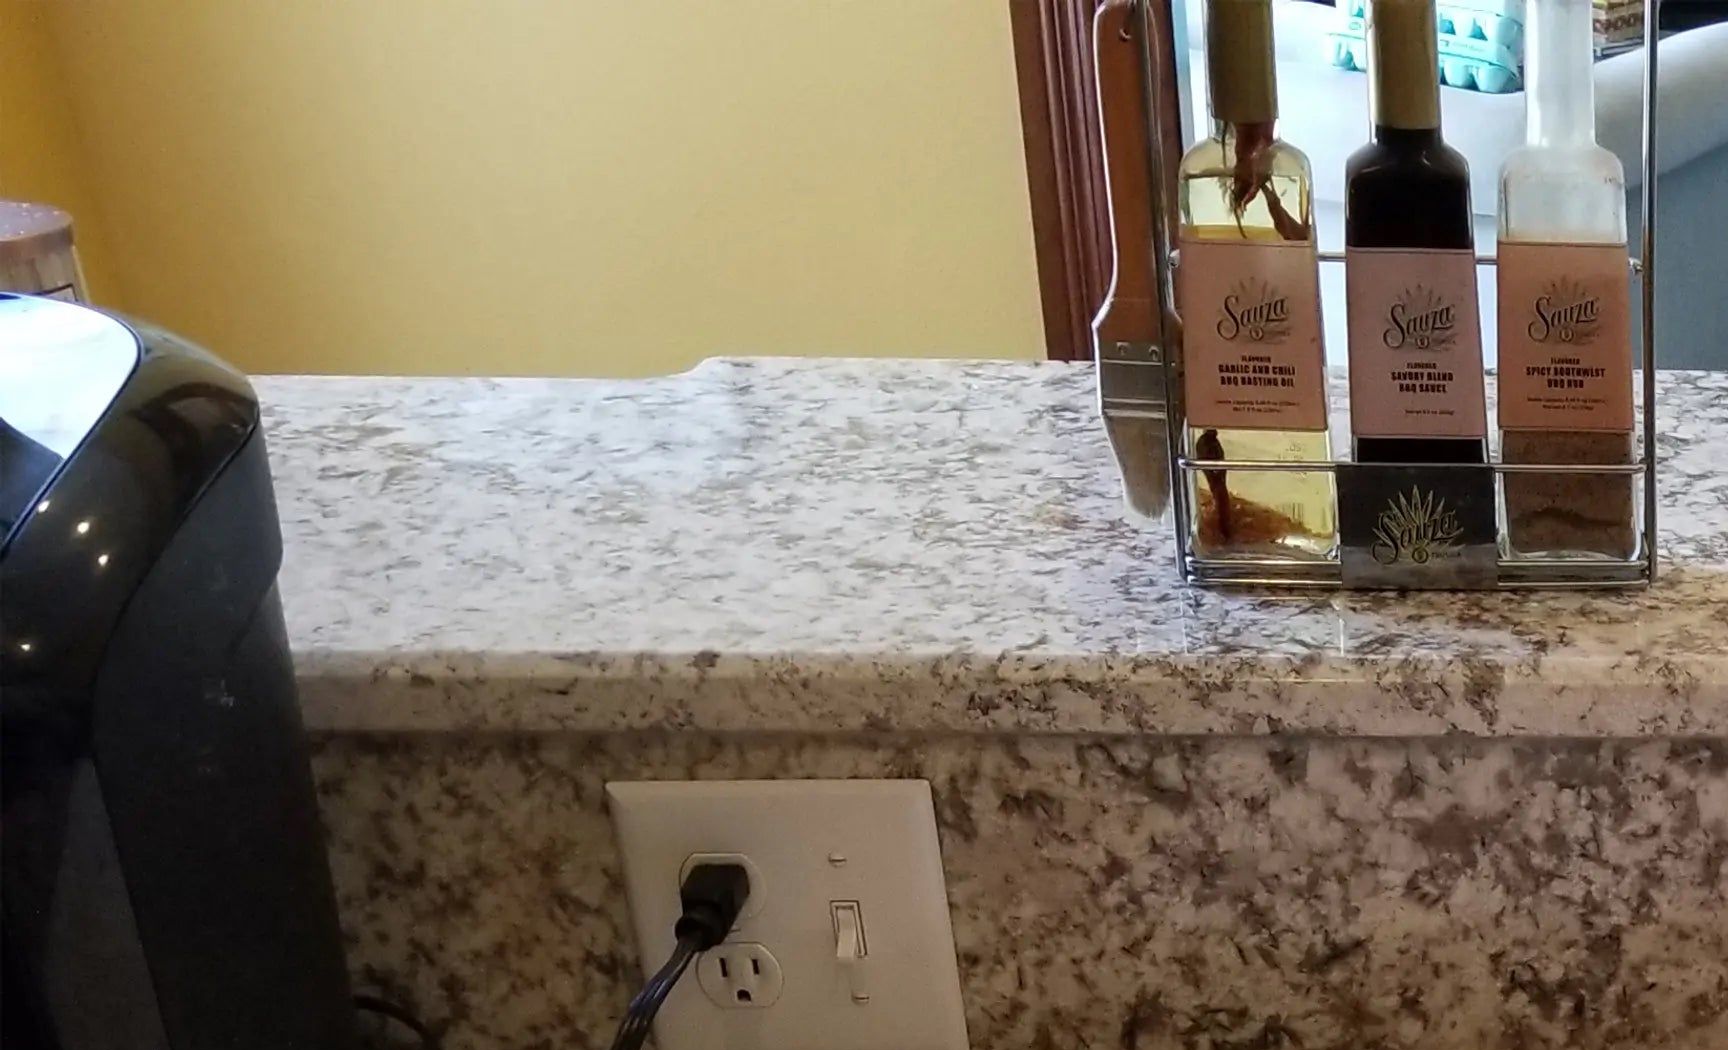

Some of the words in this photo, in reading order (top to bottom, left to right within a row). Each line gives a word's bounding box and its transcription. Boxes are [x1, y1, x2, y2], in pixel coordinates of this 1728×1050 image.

[1217, 295, 1289, 341] Sauza
[1528, 296, 1599, 342] Sauza
[1383, 303, 1455, 349] Sauza
[1218, 364, 1250, 374] GARLIC
[1252, 365, 1270, 375] AND
[1272, 366, 1296, 376] CHILI
[1391, 371, 1425, 381] SAVORY
[1526, 366, 1551, 376] SPICY
[1553, 367, 1606, 377] SOUTHWEST
[1220, 376, 1239, 387] BBQ
[1241, 376, 1279, 388] BASTING
[1281, 377, 1295, 388] OIL
[1399, 383, 1417, 393] BBQ
[1419, 383, 1447, 393] SAUCE
[1371, 510, 1458, 565] Sauza
